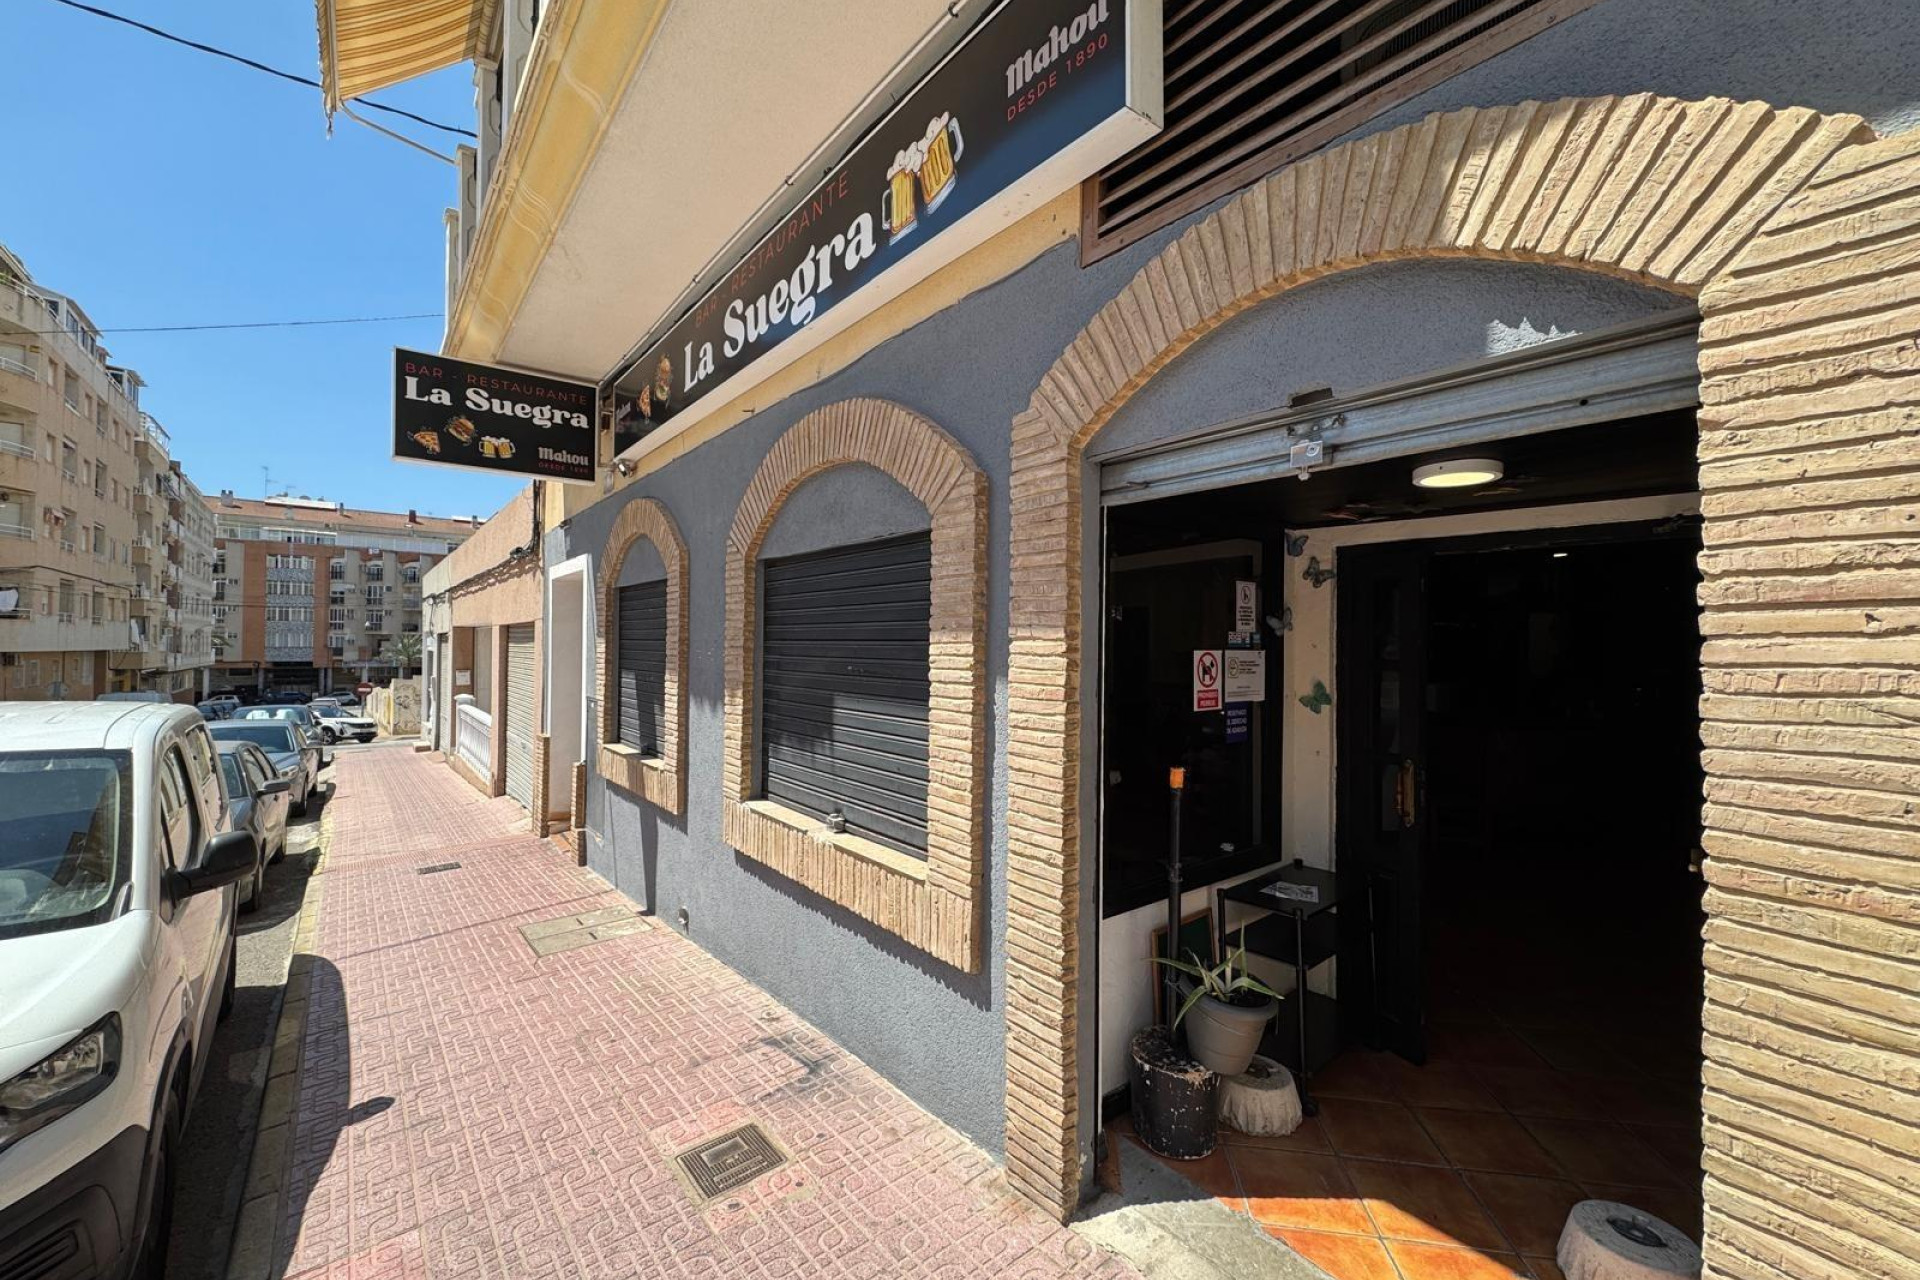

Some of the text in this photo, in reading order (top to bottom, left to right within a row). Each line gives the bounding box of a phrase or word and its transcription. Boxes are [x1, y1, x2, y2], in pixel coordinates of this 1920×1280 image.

[1005, 0, 1110, 98] Mahou
[1007, 33, 1108, 122] DESDE 1890
[731, 170, 848, 294] RESTAURANTE
[684, 212, 876, 392] La Suegra
[404, 362, 442, 377] BAR
[467, 374, 588, 405] RESTAURANTE
[405, 376, 453, 406] La
[465, 387, 589, 428] Suegra
[538, 447, 589, 466] Mahou
